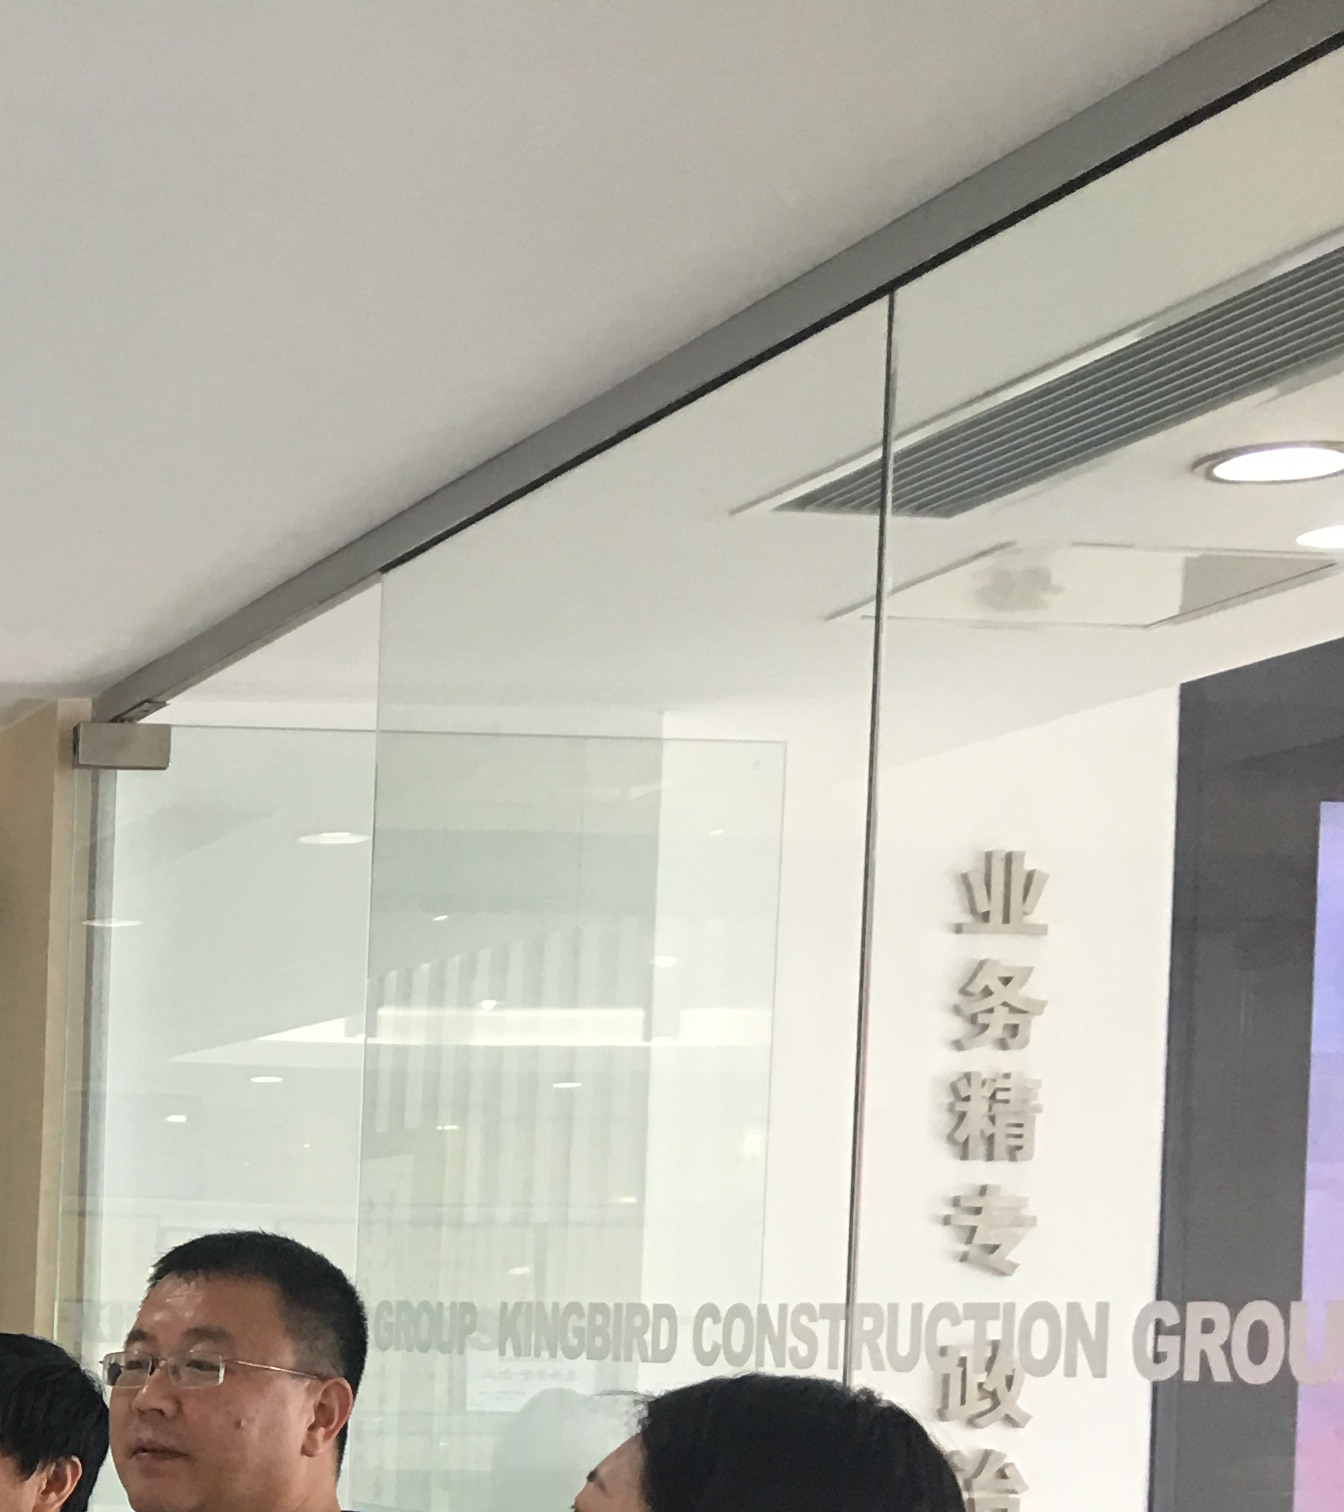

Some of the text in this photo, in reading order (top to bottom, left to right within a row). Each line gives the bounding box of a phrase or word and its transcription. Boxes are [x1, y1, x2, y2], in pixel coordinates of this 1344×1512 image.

[943, 850, 1049, 1276] 业务精专
[374, 1300, 478, 1355] GROUP
[498, 1301, 678, 1363] KINGBIRD
[693, 1301, 1110, 1378] CONSTRUCTION
